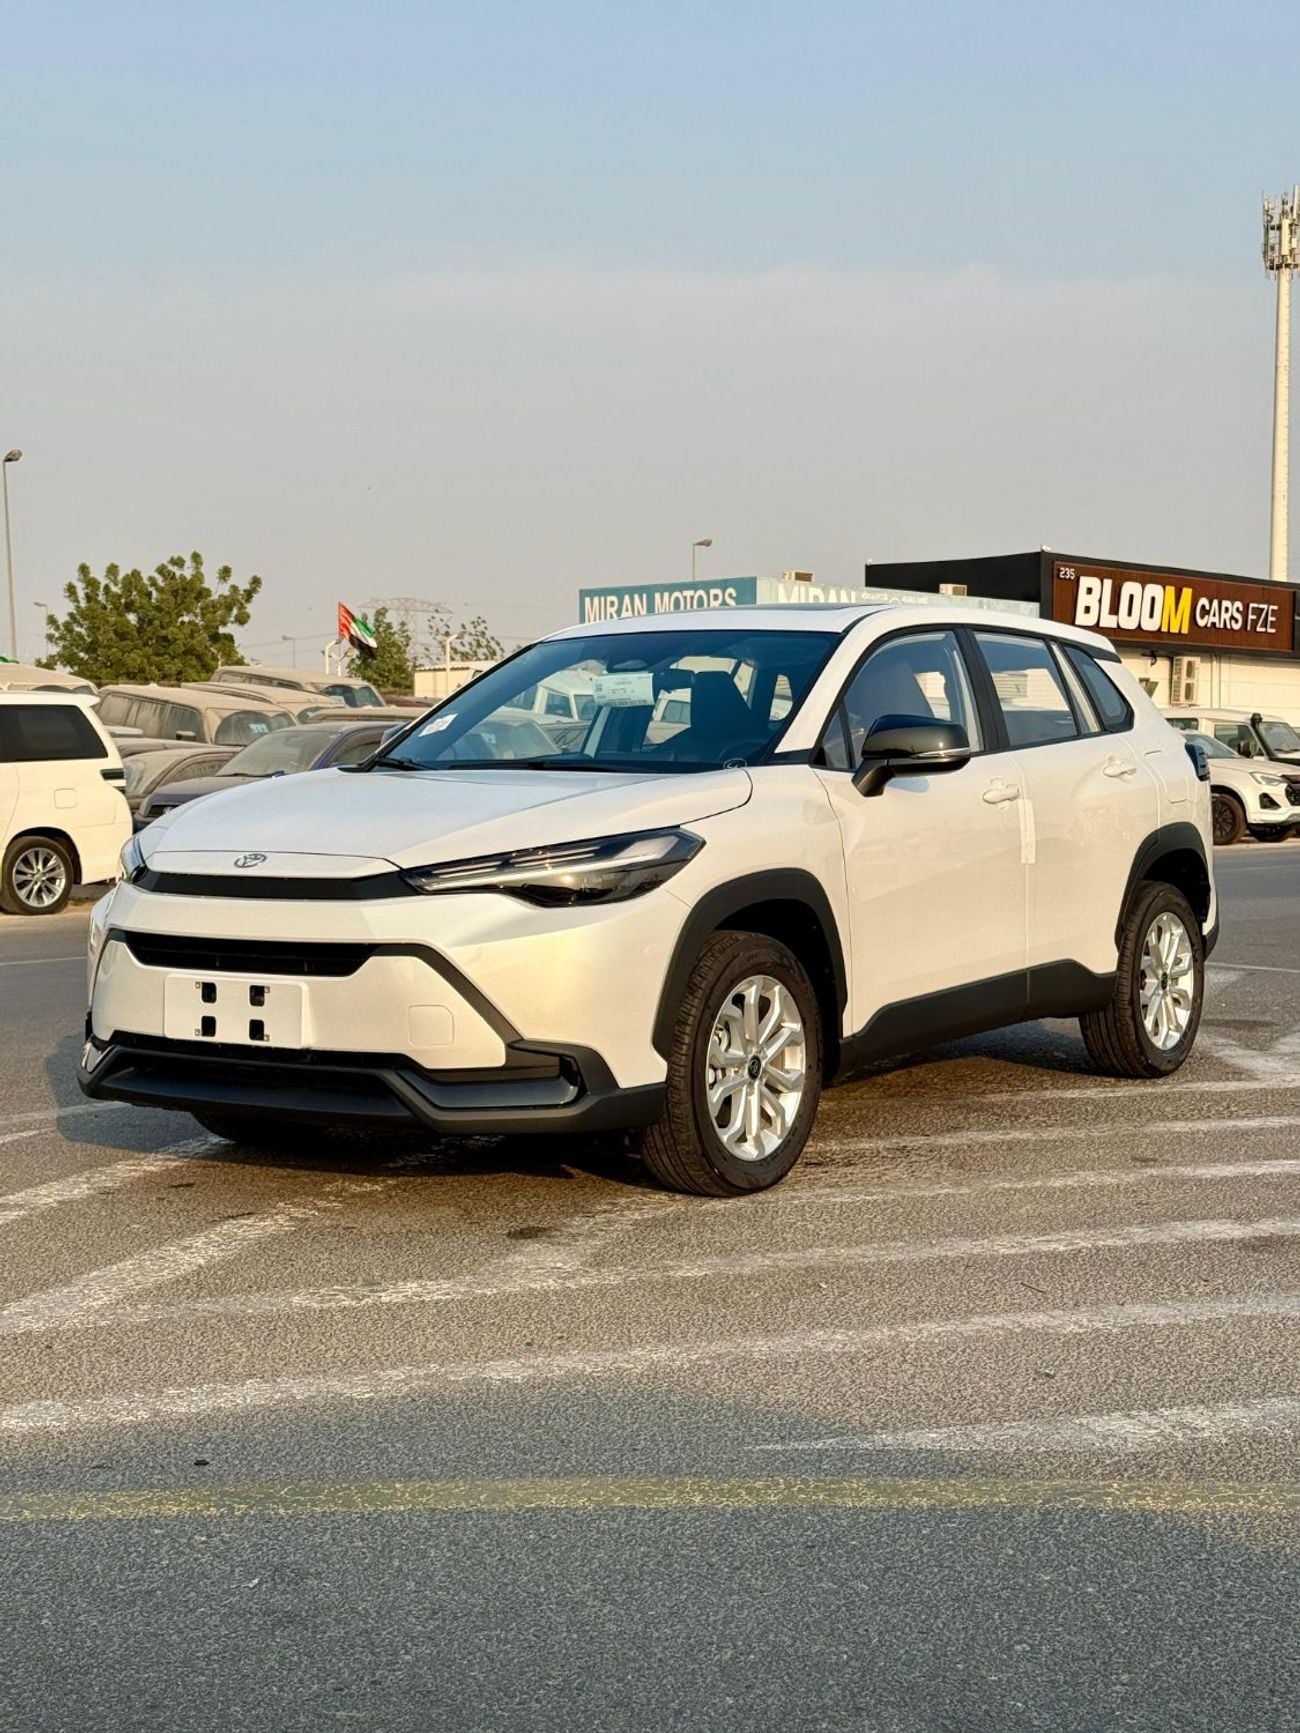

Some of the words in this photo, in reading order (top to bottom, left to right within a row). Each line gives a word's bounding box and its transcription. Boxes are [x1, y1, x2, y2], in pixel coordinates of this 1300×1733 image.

[1060, 567, 1075, 580] 235
[585, 593, 647, 624] MIRAN
[654, 587, 737, 614] MOTORS
[1075, 576, 1193, 634] BLOOM
[1195, 597, 1243, 630] CARS
[1247, 603, 1278, 633] FZE
